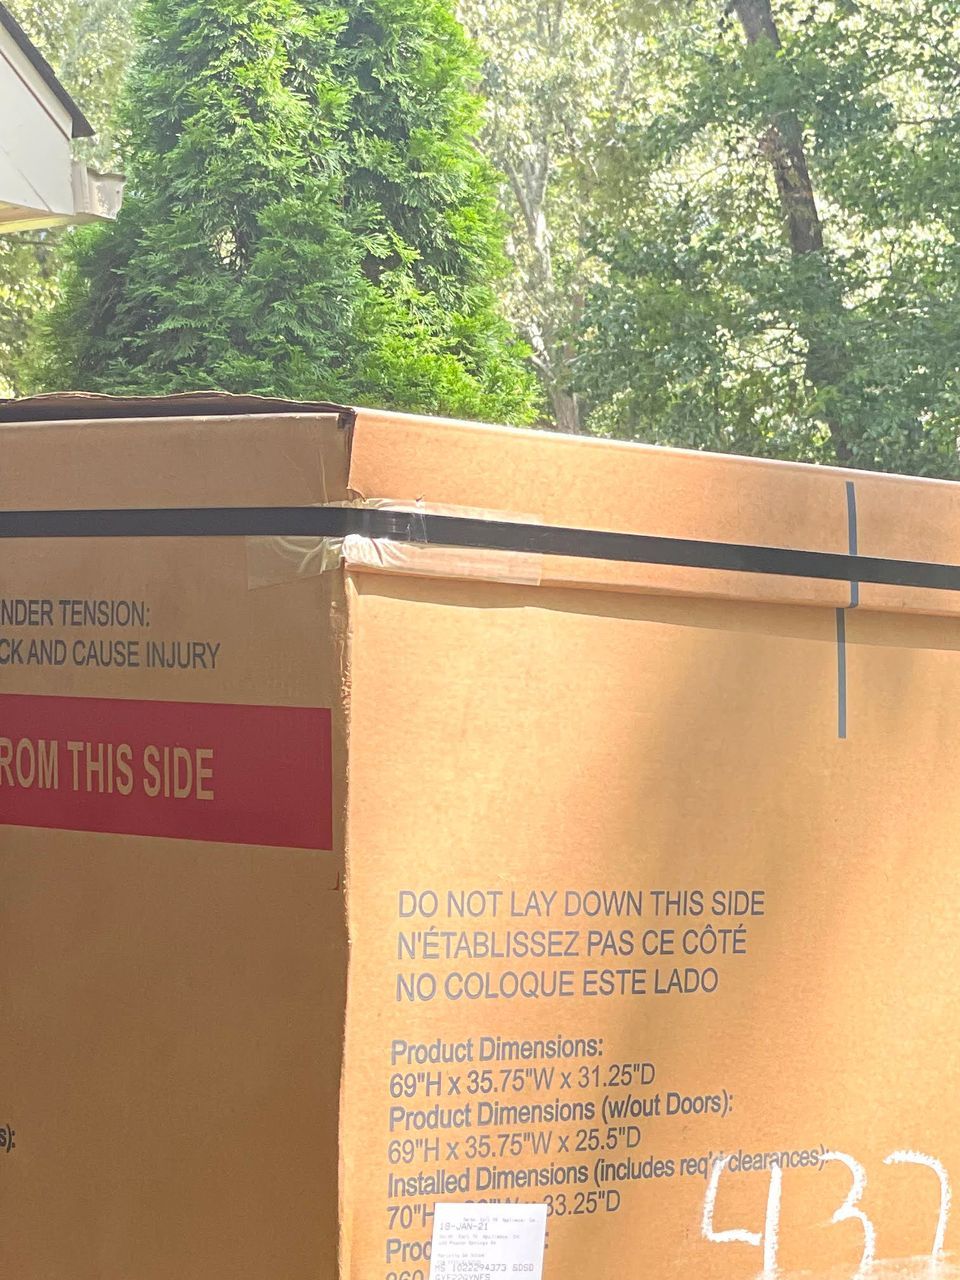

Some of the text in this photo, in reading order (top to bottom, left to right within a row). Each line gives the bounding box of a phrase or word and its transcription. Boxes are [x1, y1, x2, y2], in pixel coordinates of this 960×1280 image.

[59, 600, 150, 627] TENSION:
[27, 639, 67, 666] AND
[72, 640, 140, 667] CAUSE
[146, 641, 220, 669] INJURY
[67, 741, 134, 796] THIS
[143, 744, 215, 801] SIDE
[399, 889, 766, 919] DO NOT LAY DOWN THIS SIDE
[397, 923, 747, 959] N'ÉTABLISSEZ PAS CE CÔTÉ
[396, 967, 718, 1001] NO COLOQUE ESTE LADO
[390, 1034, 604, 1066] Product Dimensions:
[389, 1063, 656, 1098] 69"H x 35.75"W x 31.25"D
[389, 1089, 734, 1132] Product Dimensions (w/out Doors):
[388, 1126, 642, 1165] 69"H x 35.75"W x 25.5"D
[388, 1168, 470, 1198] Installed
[476, 1161, 589, 1191] Dimensions
[593, 1155, 674, 1188] (includes
[728, 1143, 829, 1173] clearances):
